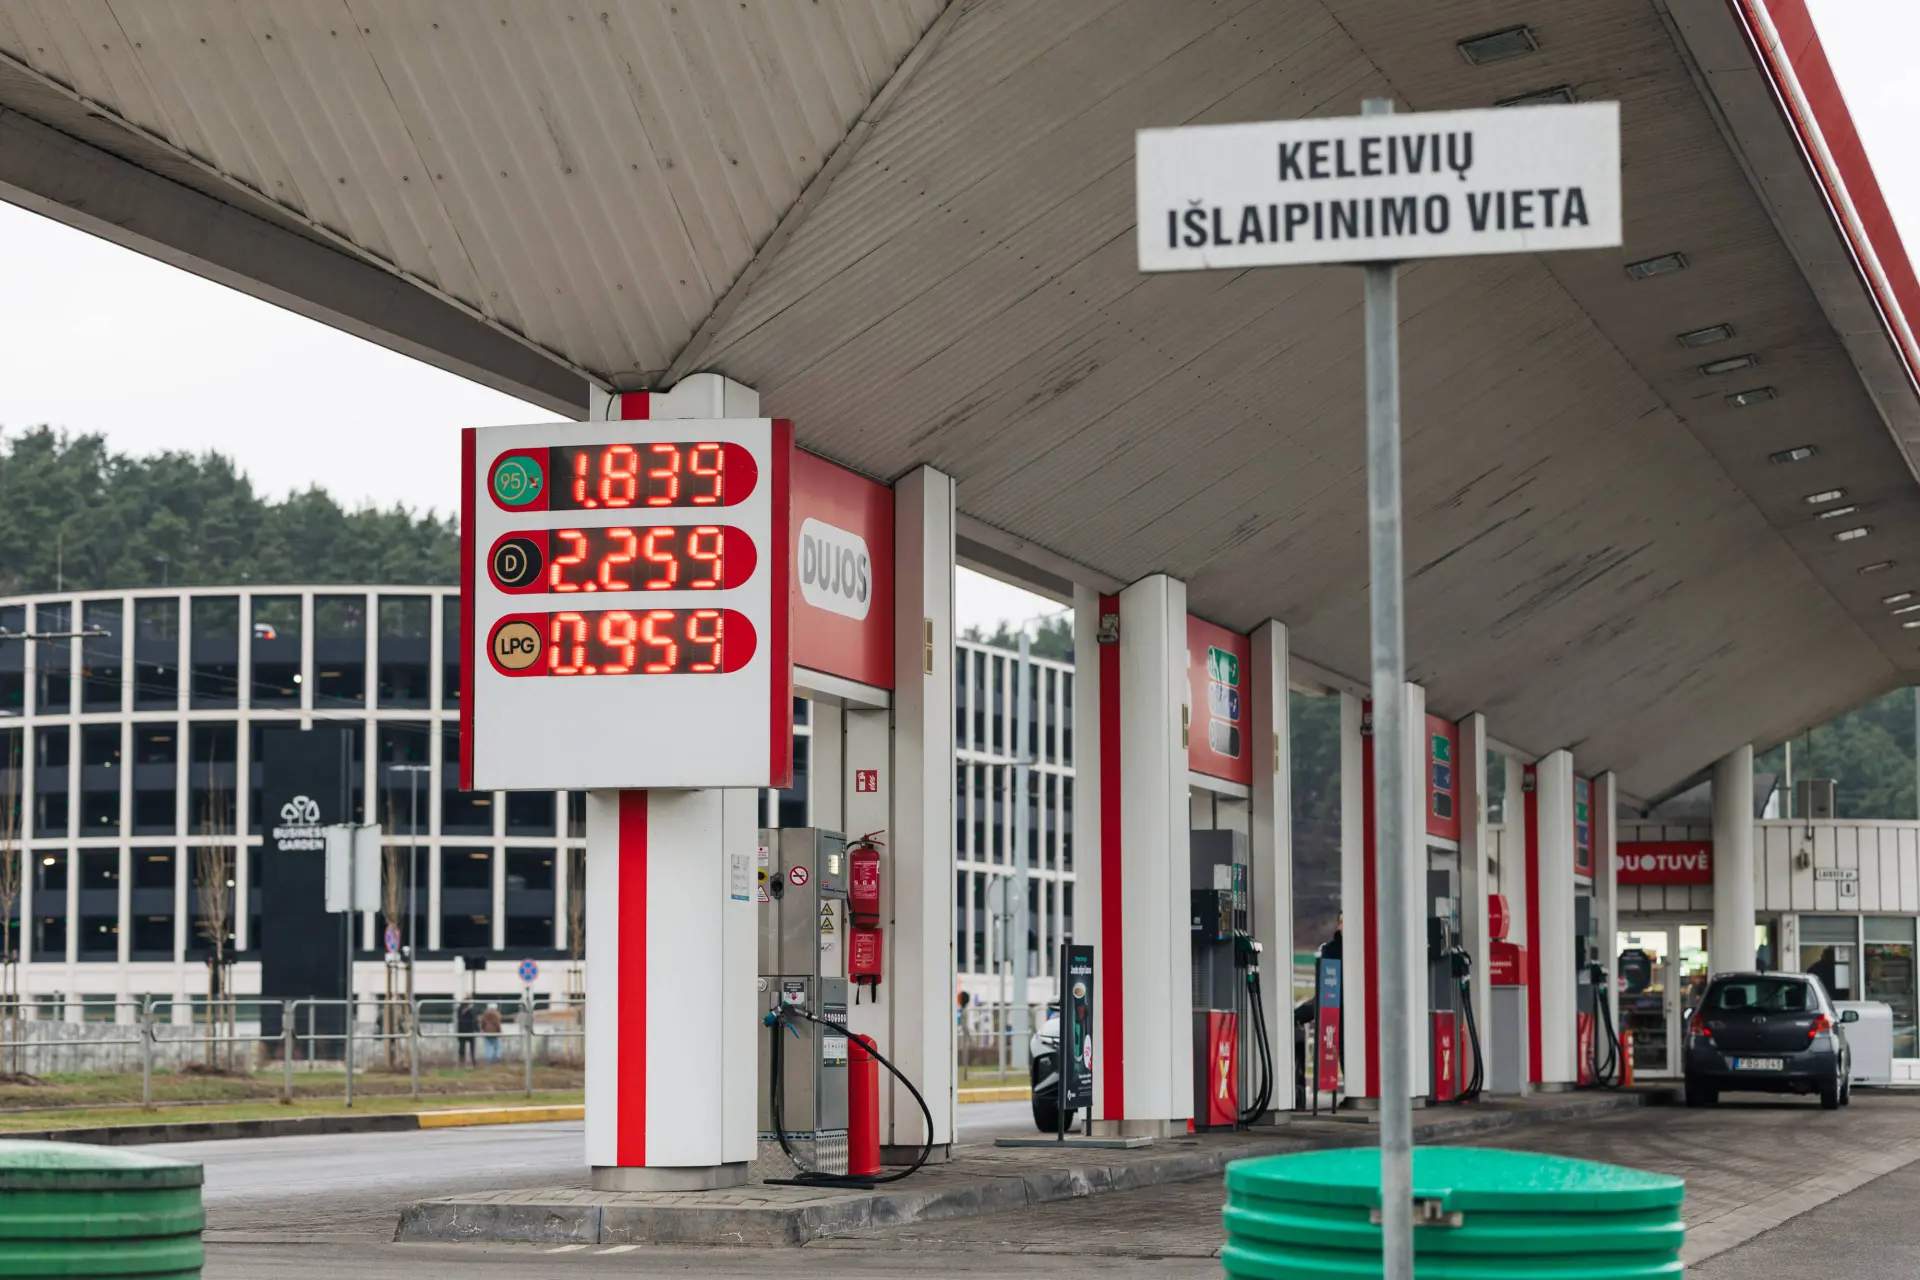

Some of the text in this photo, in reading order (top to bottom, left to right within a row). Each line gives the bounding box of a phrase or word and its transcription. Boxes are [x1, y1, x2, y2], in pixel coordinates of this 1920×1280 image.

[1277, 130, 1474, 181] KELEIVIŲ
[1167, 186, 1591, 249] IŠLAIPINIMO VIETA
[500, 473, 521, 490] 95
[573, 442, 725, 508] 1.839
[505, 526, 724, 592] D 2.259
[803, 533, 867, 603] DUJOS
[501, 610, 724, 675] LPG 0.959
[278, 839, 324, 851] GARDEN
